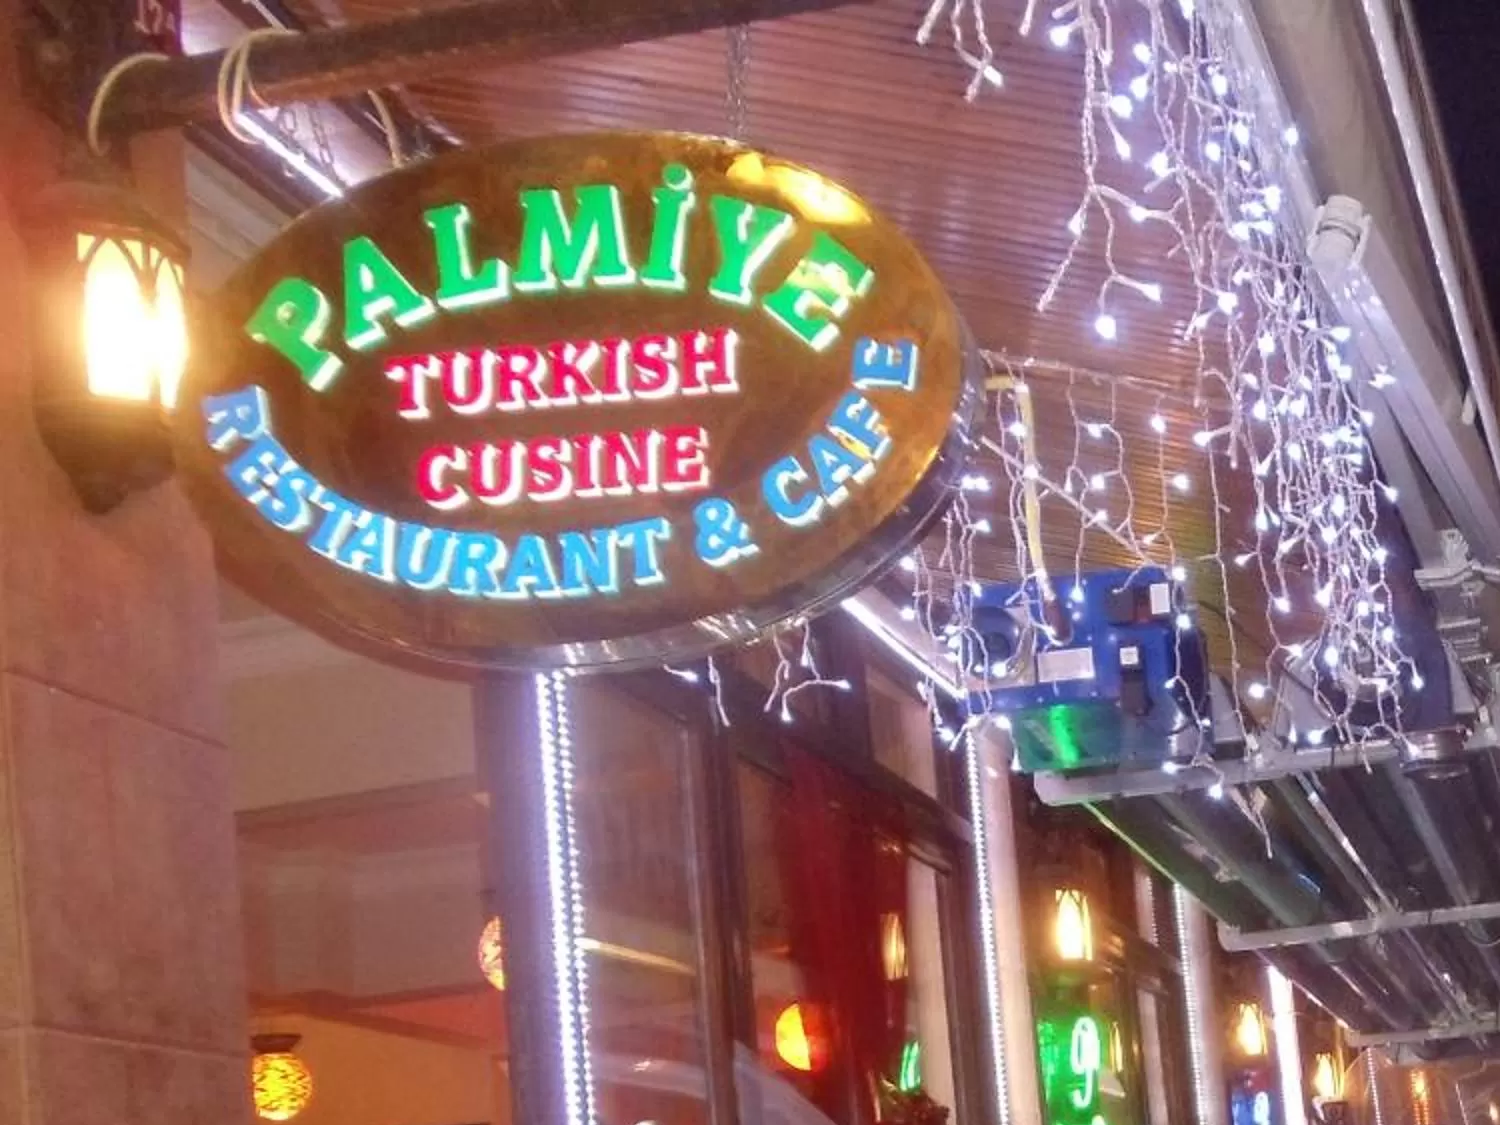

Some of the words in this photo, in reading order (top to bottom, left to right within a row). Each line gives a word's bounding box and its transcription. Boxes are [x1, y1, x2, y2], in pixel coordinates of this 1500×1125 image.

[384, 327, 741, 420] TURKISH
[202, 384, 670, 600] RESTAURANT
[691, 497, 758, 568] &
[761, 336, 920, 527] CAFE
[415, 425, 712, 510] CUSINE
